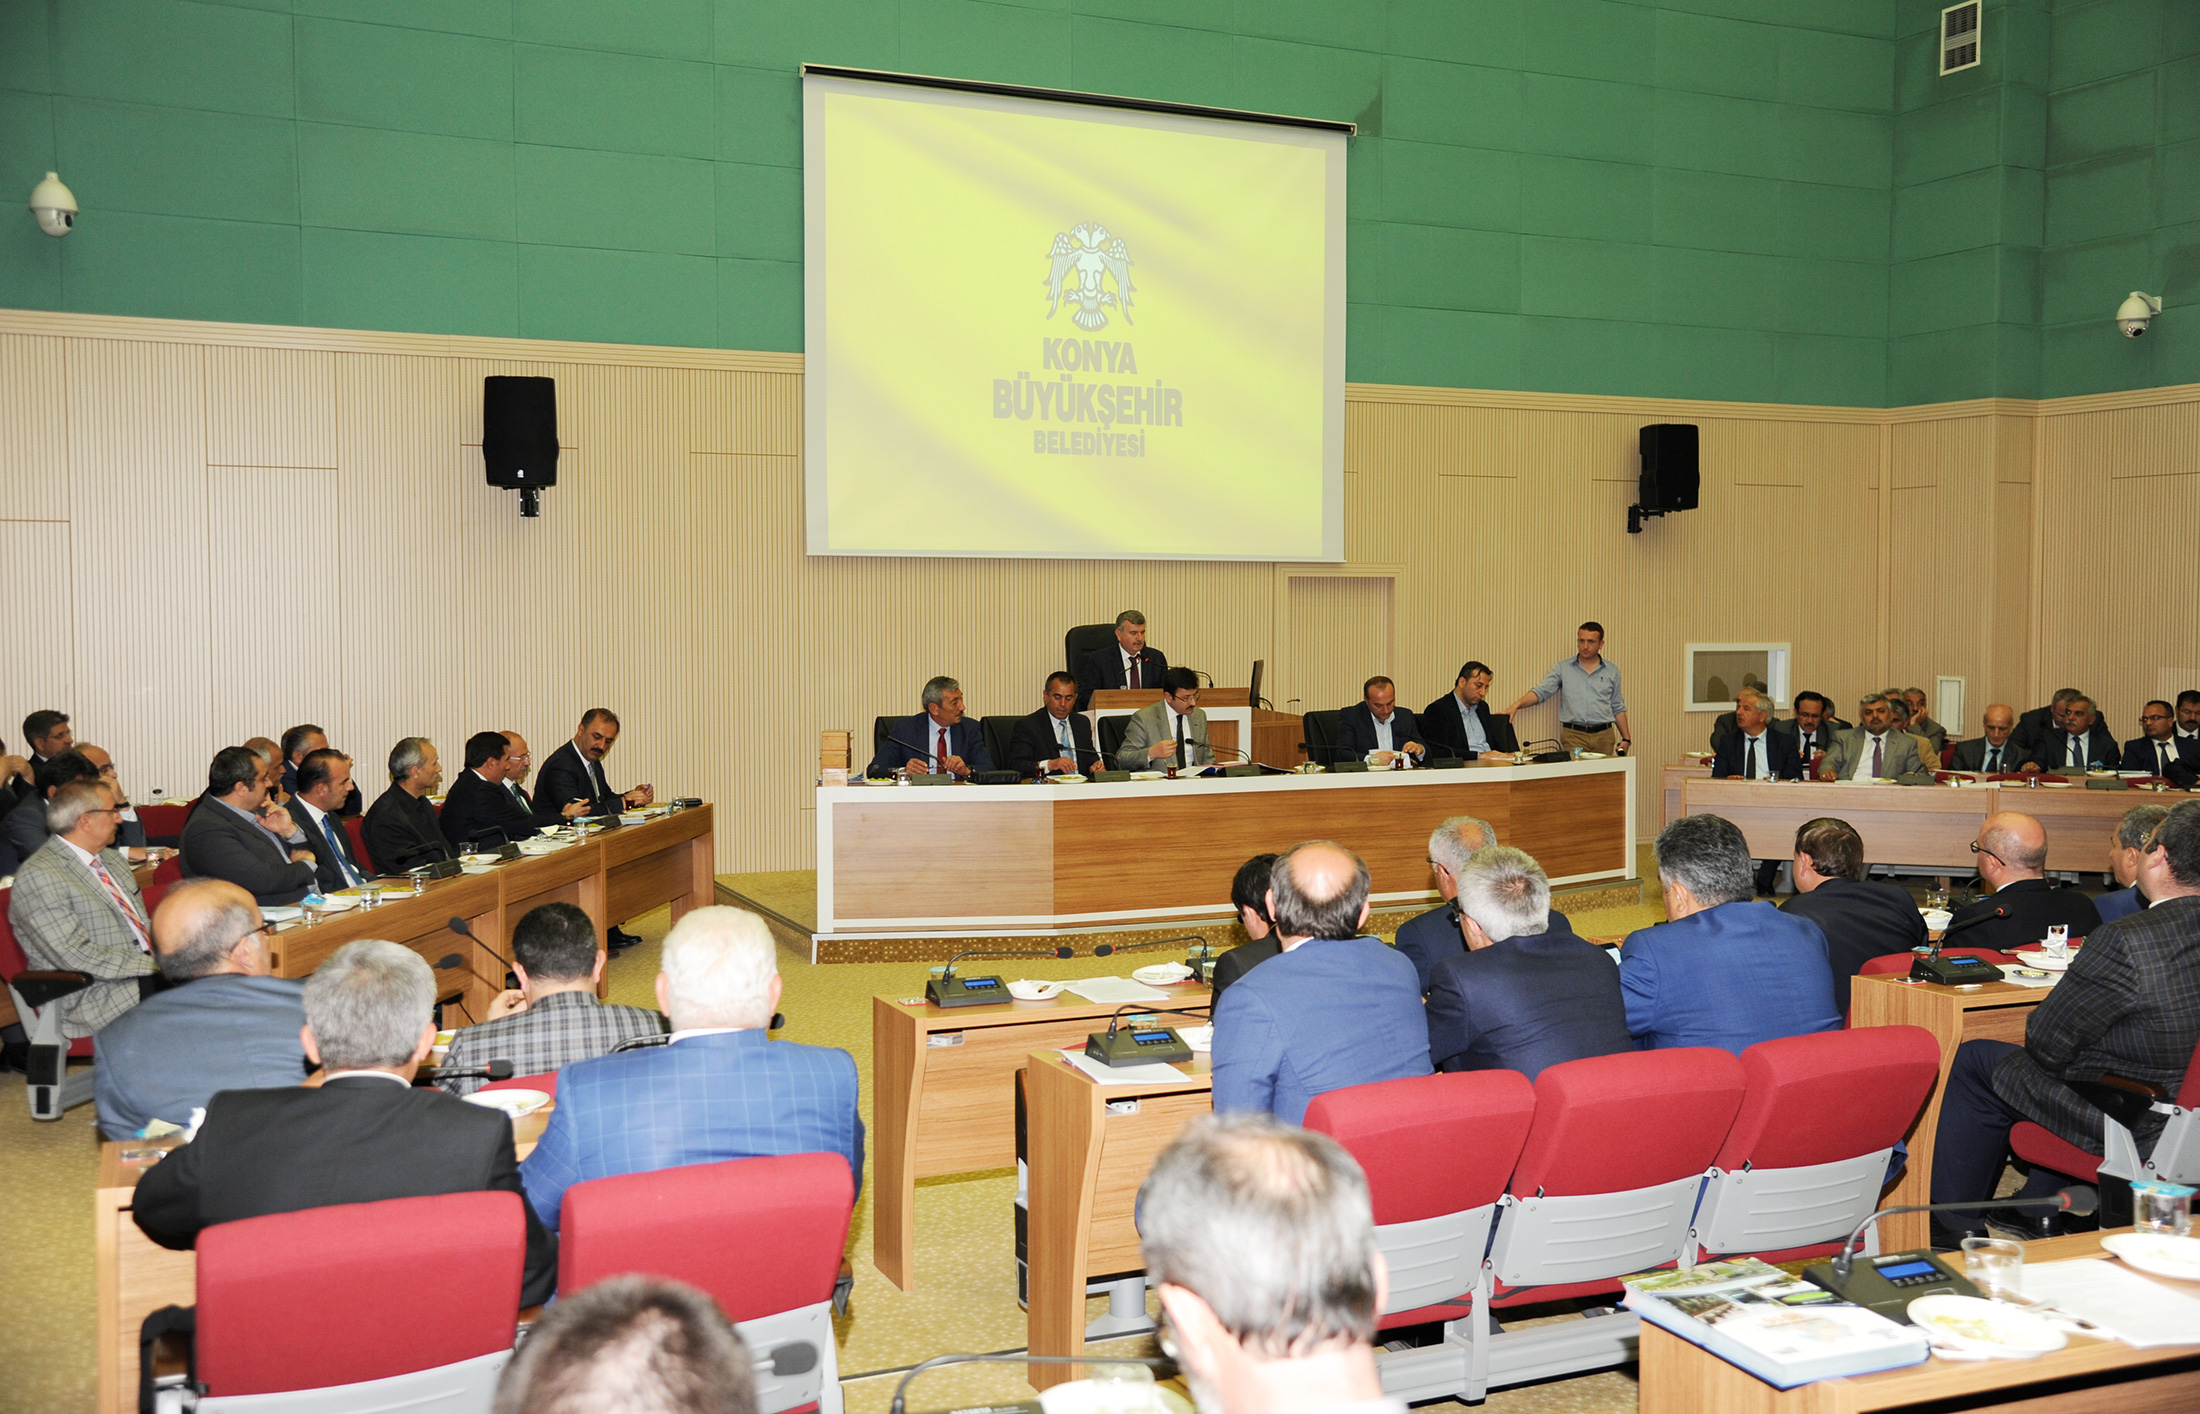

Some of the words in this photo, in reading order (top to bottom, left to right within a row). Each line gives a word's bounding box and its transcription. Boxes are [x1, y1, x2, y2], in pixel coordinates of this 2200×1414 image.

[1043, 337, 1138, 375] KONYA
[993, 371, 1183, 430] BÜYÜKŞEHİR
[1033, 427, 1146, 458] BELEDİYESİ
